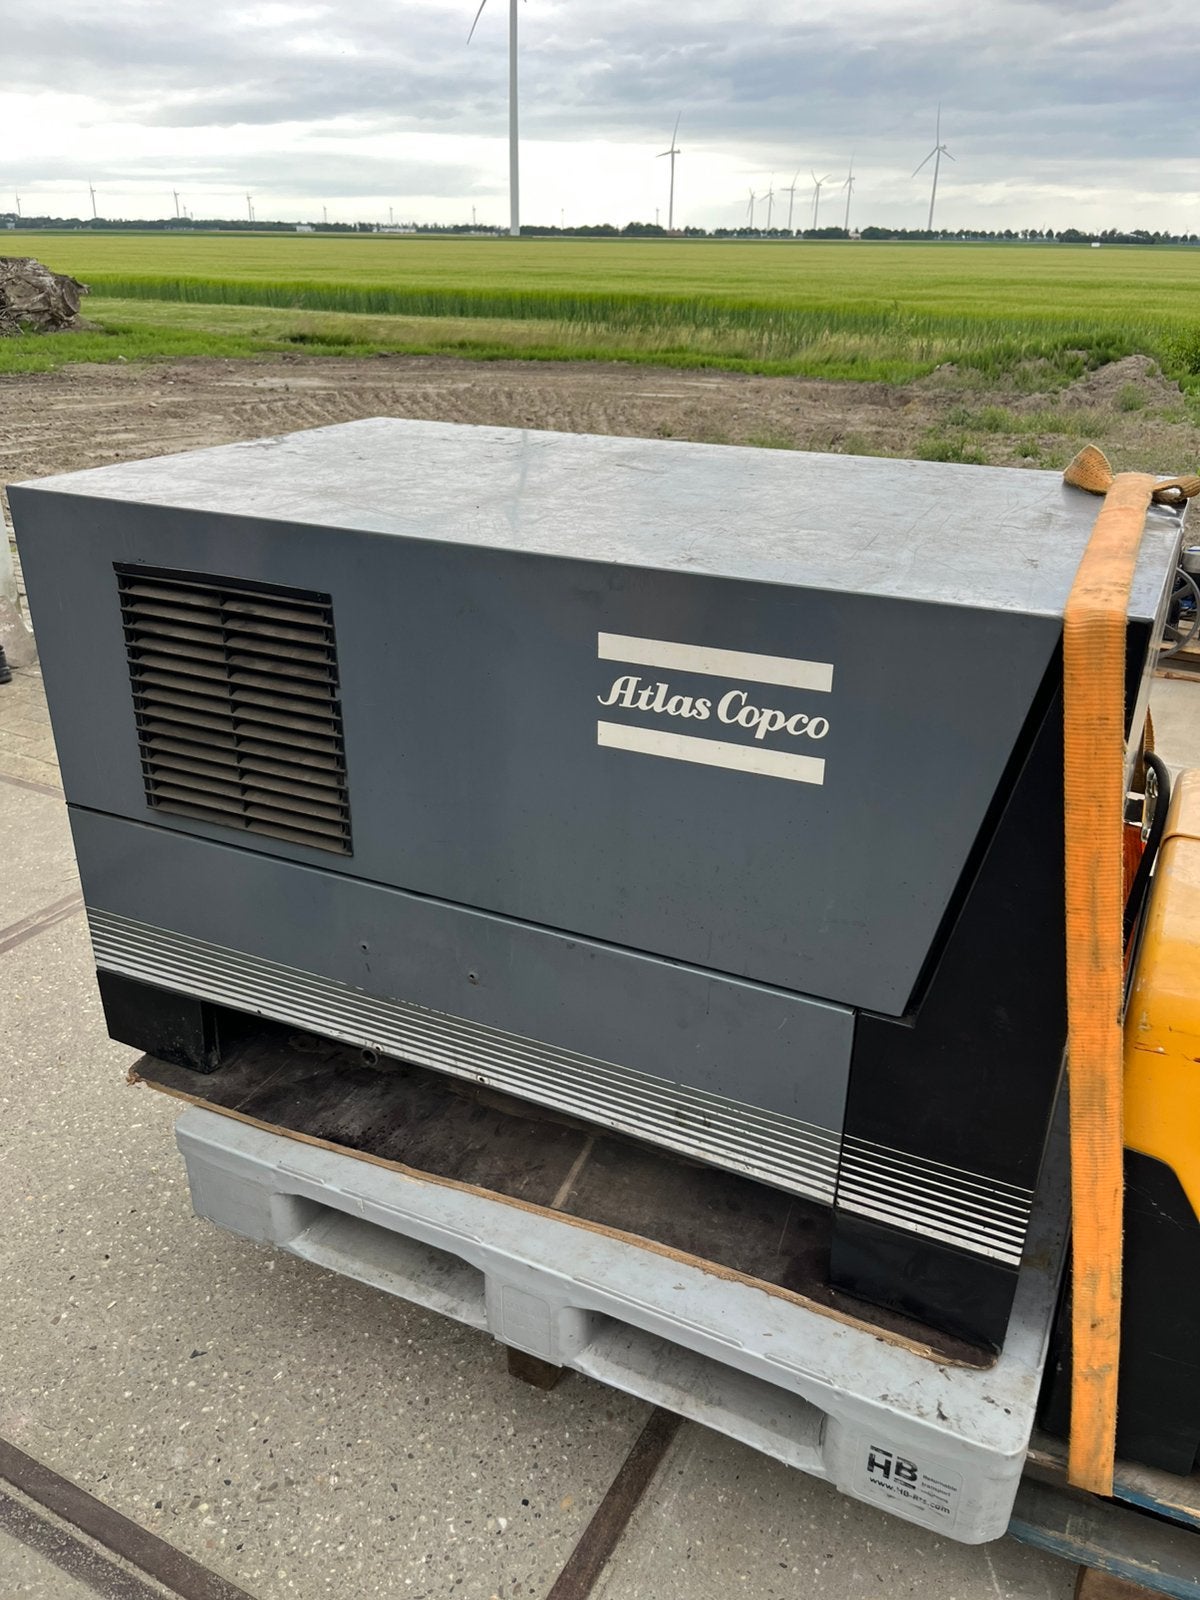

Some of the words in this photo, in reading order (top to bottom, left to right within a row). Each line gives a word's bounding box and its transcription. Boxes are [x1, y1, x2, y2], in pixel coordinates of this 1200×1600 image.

[597, 675, 712, 720] Atlas
[716, 690, 830, 740] Copco
[867, 1452, 918, 1482] HB
